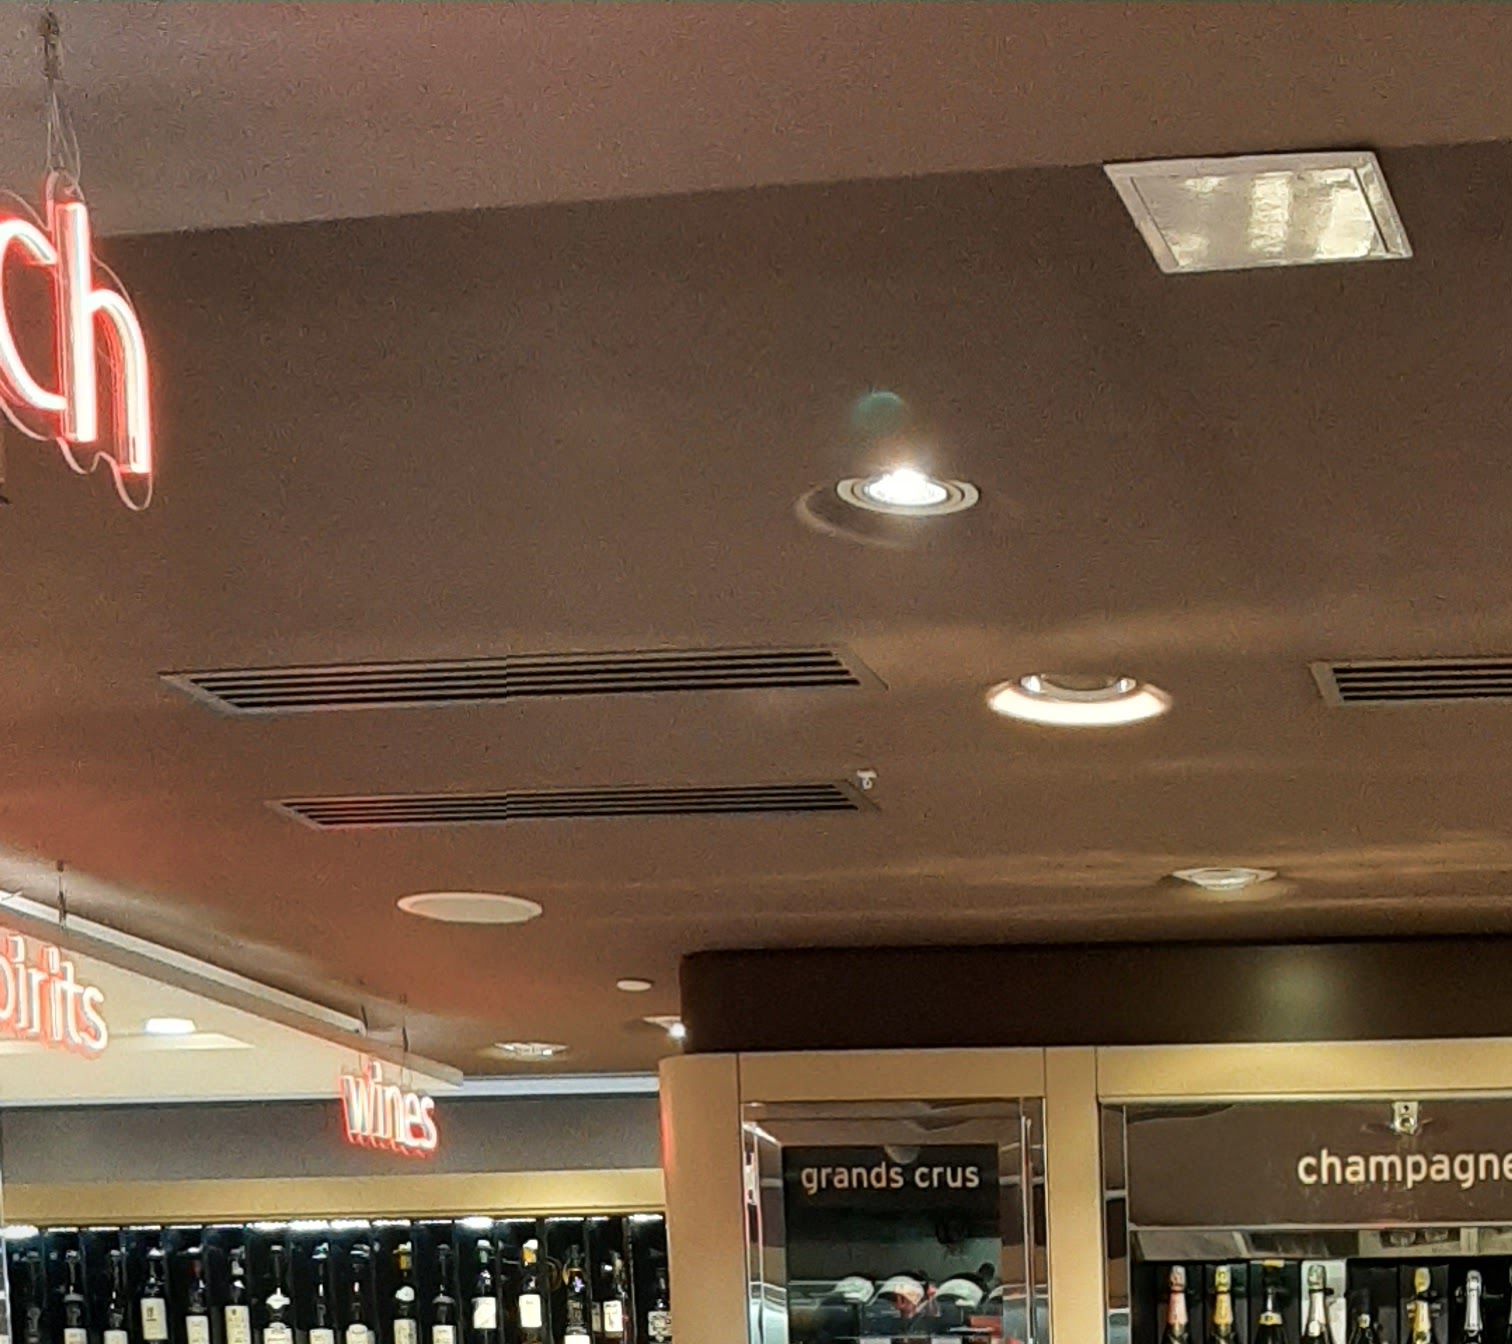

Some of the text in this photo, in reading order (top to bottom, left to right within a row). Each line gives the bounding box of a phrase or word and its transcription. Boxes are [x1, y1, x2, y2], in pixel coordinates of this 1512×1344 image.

[341, 1062, 438, 1151] wines
[802, 1161, 980, 1194] grands crus
